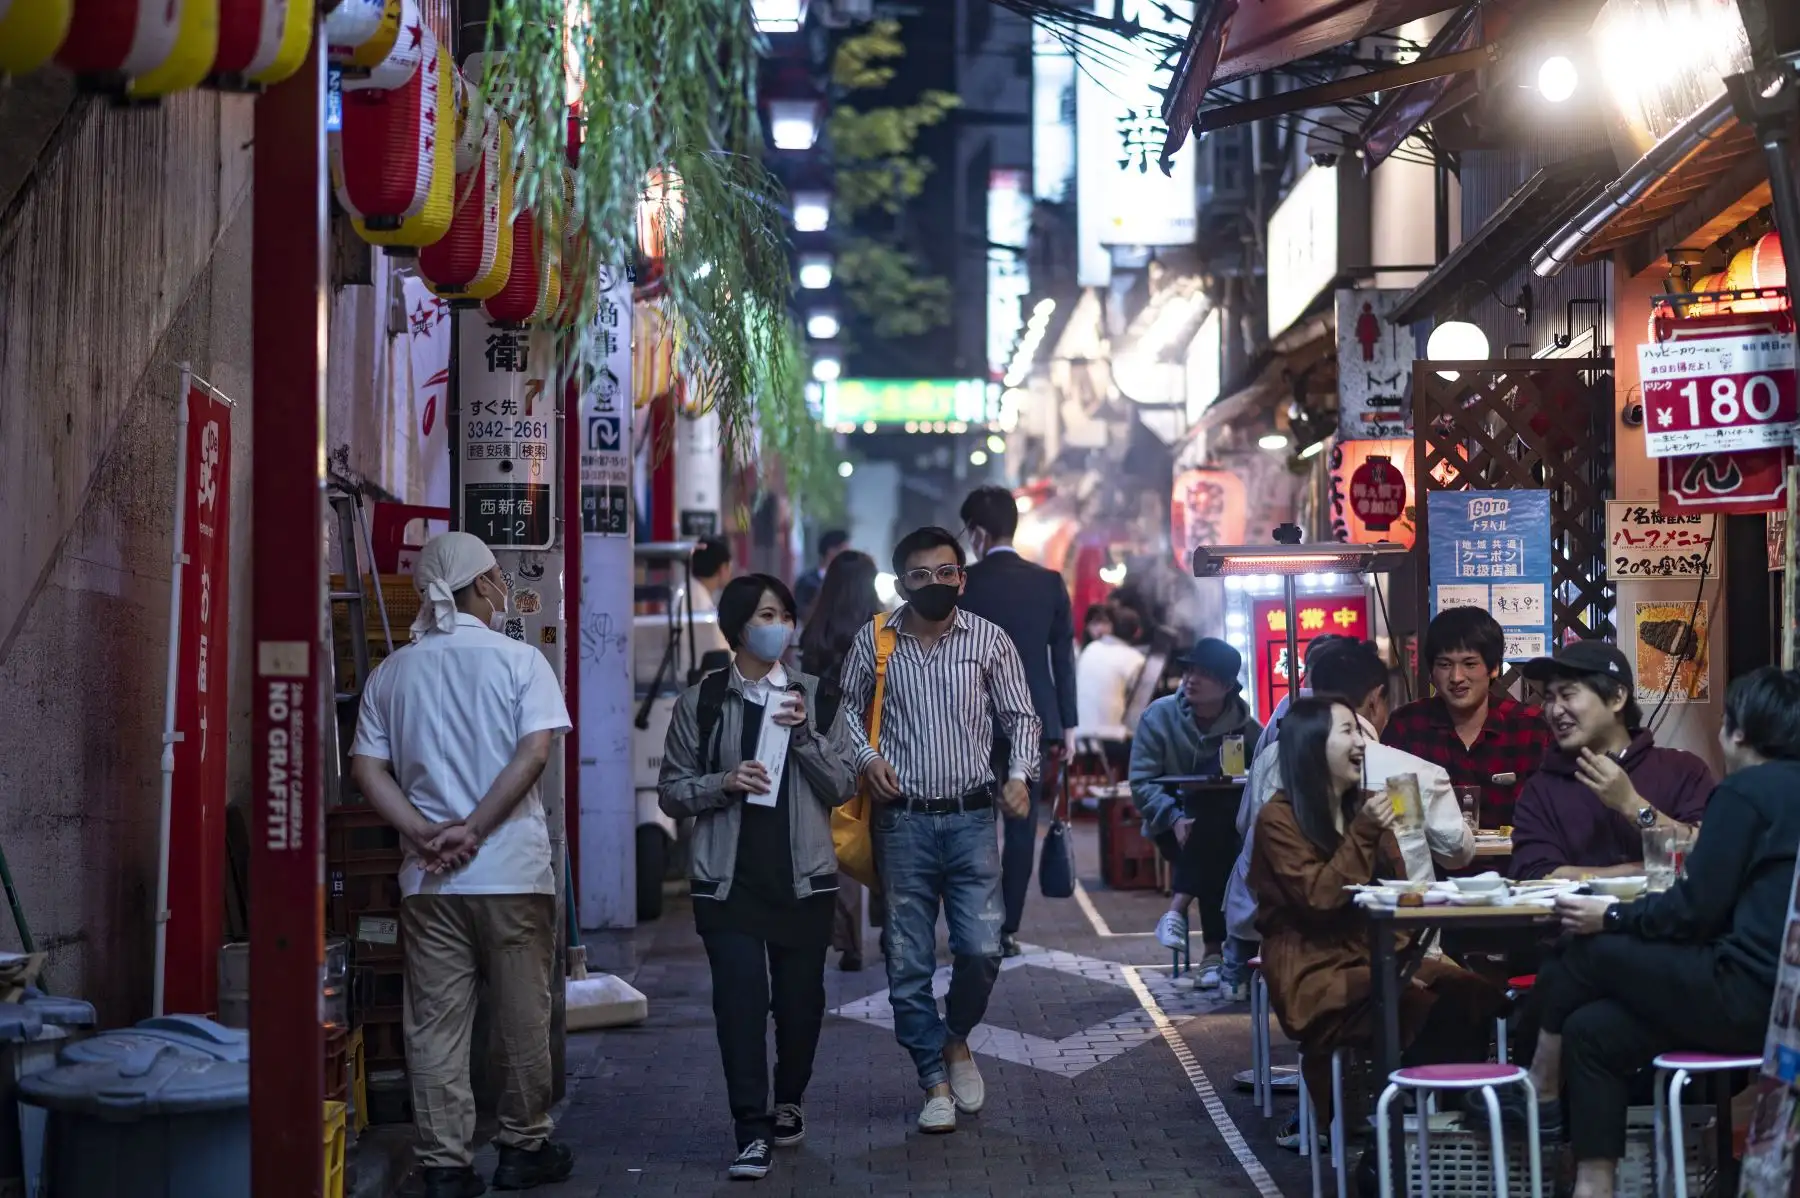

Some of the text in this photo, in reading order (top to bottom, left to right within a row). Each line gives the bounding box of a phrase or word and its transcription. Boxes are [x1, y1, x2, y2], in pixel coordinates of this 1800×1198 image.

[1643, 380, 1673, 392] ドリンク
[470, 398, 518, 416] すぐ先
[1679, 375, 1780, 426] 180
[467, 420, 548, 440] 3342-2661
[521, 443, 546, 458] 検索
[480, 498, 533, 515] 西新宿
[487, 520, 526, 537] 1-2
[1472, 520, 1507, 532] トラベル
[1462, 539, 1517, 549] 地域共通
[1612, 528, 1711, 547] ハーフメニュー
[1462, 550, 1517, 563] クーポン
[1462, 563, 1518, 576] 取扱店舗
[268, 682, 288, 850] NO GRAFFITI
